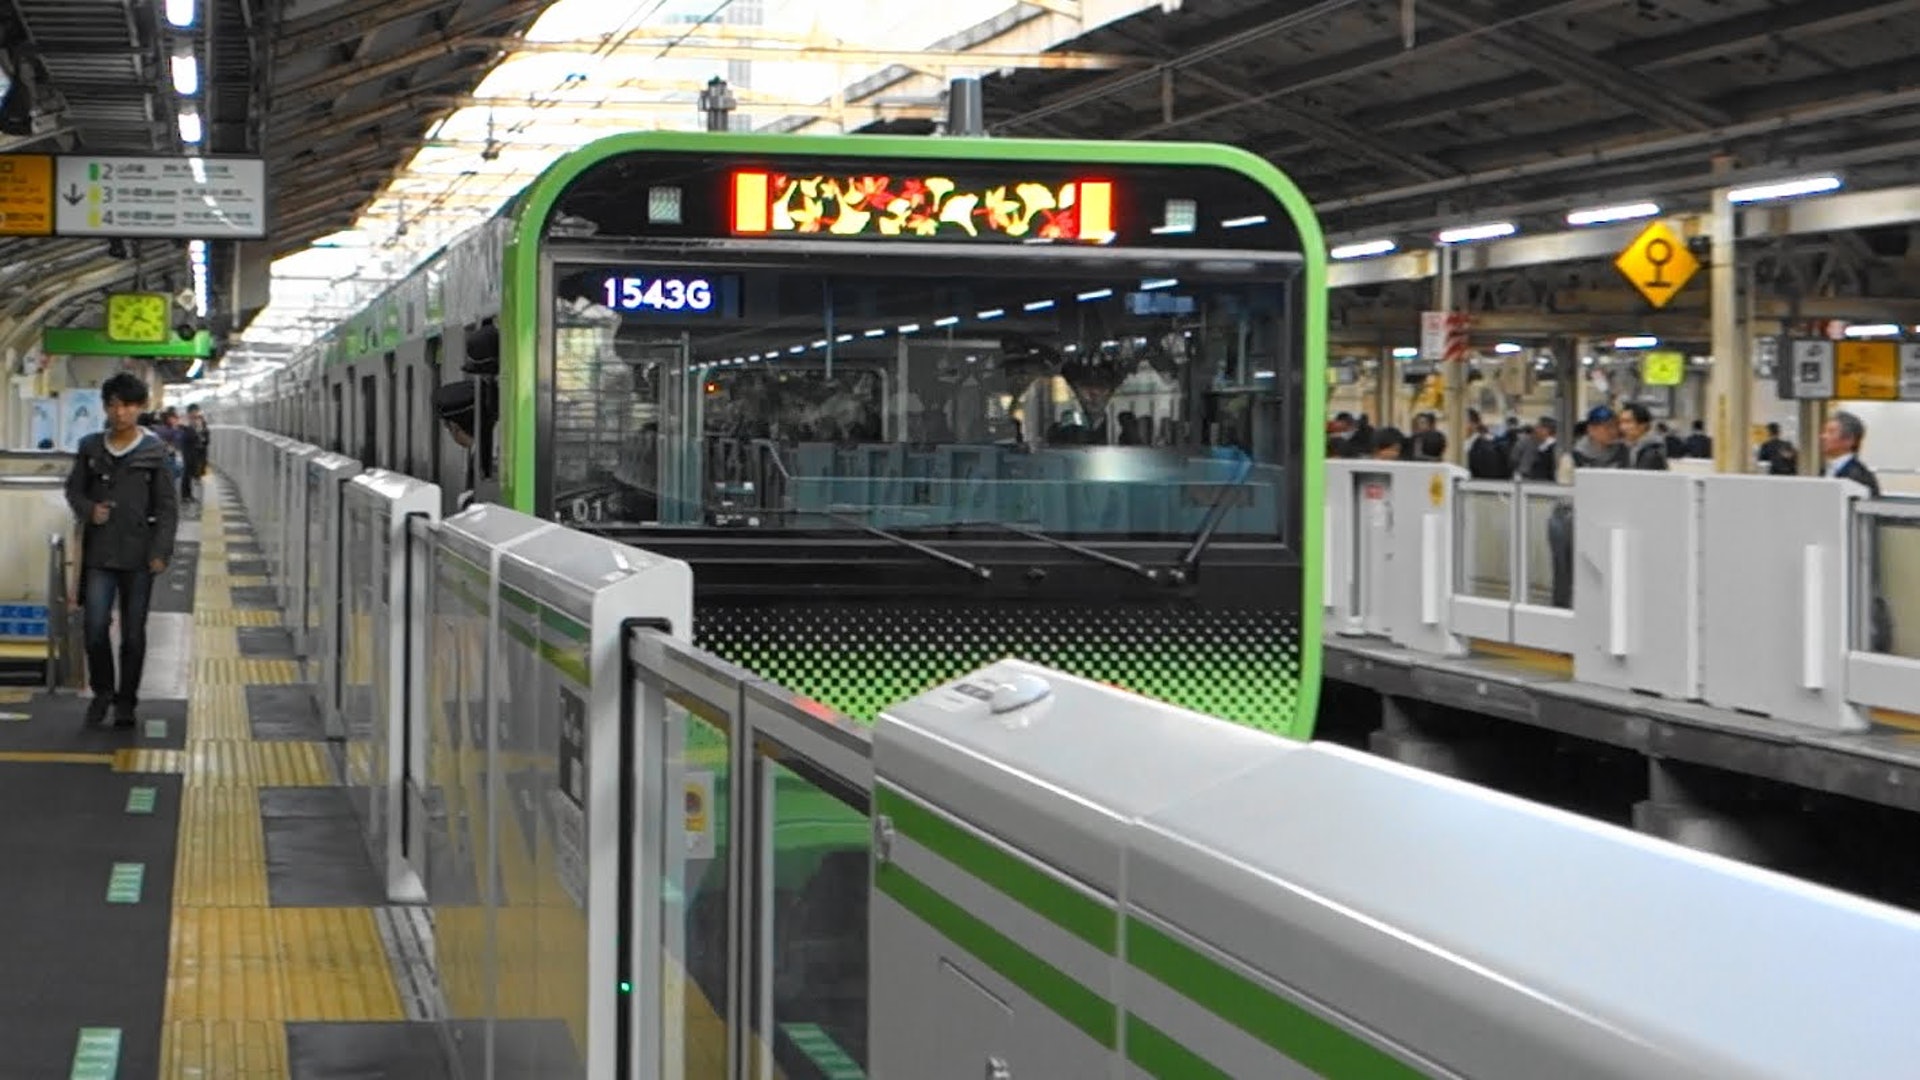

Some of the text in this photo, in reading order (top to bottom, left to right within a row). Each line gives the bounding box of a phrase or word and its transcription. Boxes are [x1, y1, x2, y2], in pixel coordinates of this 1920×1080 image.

[102, 163, 113, 180] 2
[102, 186, 113, 204] 3
[102, 210, 113, 226] 4
[603, 277, 712, 310] 1543G
[572, 498, 603, 521] 01
